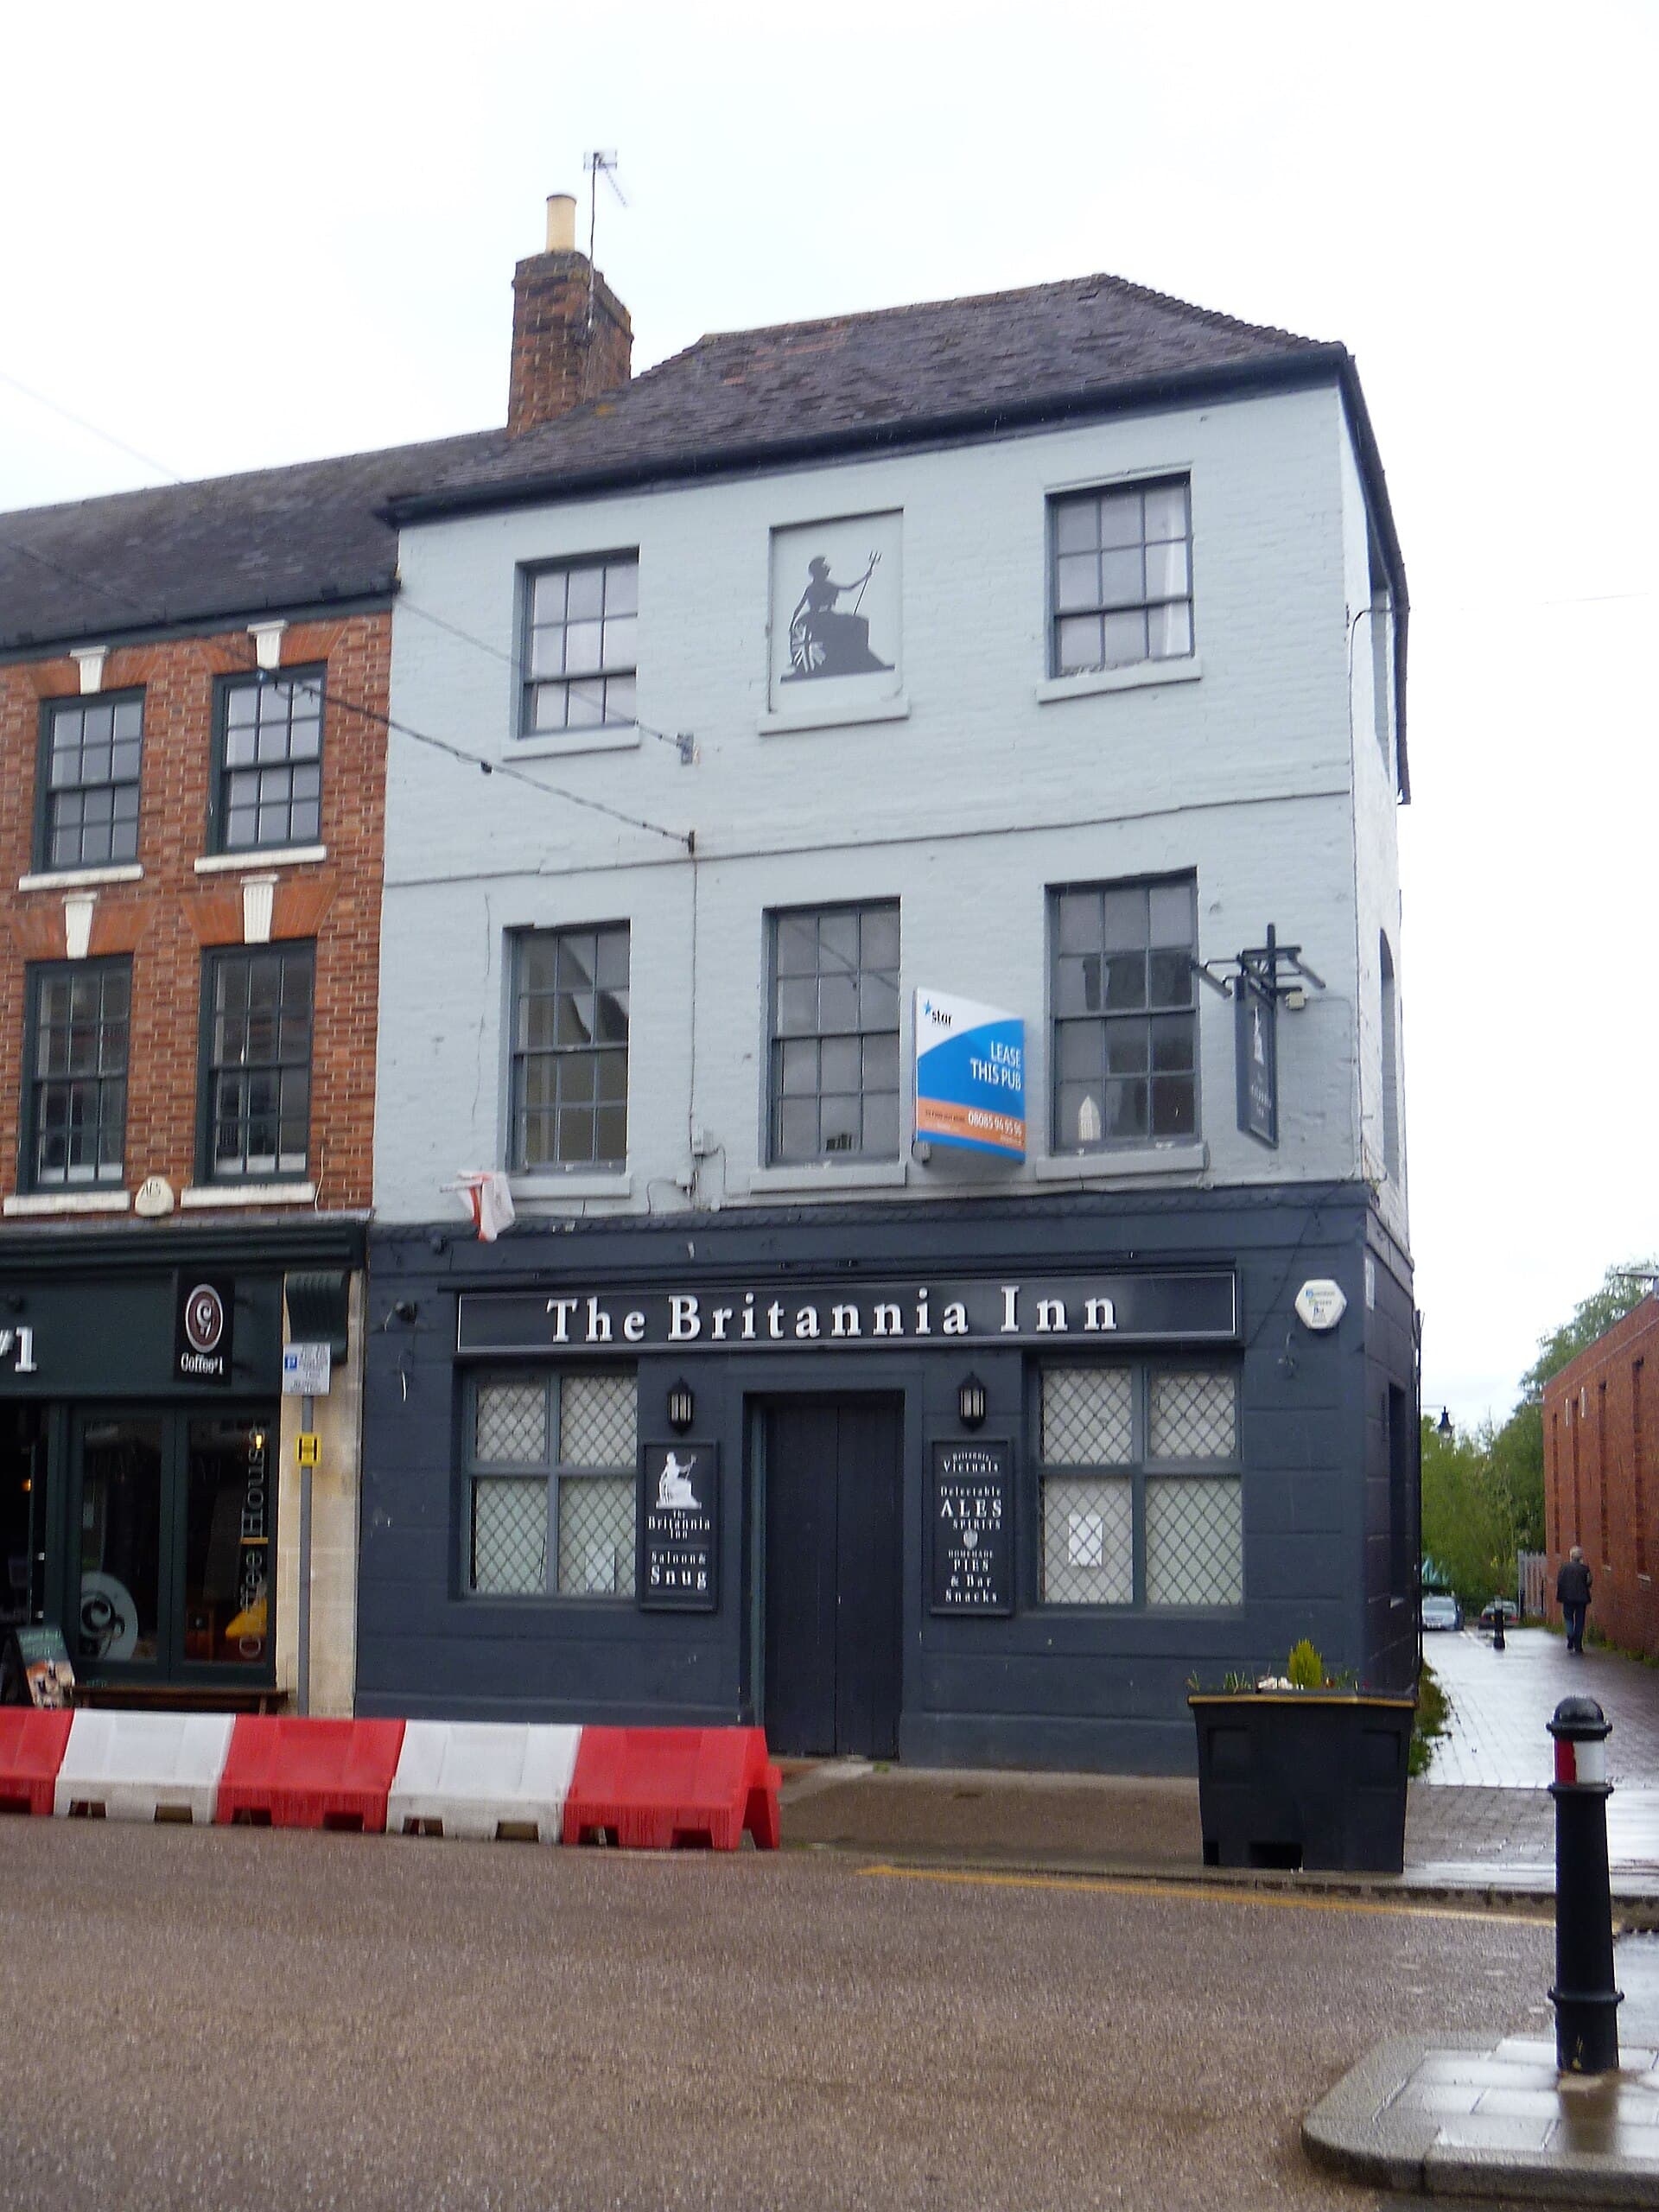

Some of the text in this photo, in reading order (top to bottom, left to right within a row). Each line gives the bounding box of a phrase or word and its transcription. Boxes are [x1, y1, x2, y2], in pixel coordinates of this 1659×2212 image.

[931, 1008, 953, 1028] star
[990, 1039, 1022, 1070] LEASE
[969, 1058, 1022, 1092] THIS PUB
[546, 1285, 1118, 1343] The Britannia Inn
[940, 1485, 1001, 1497] Delectable
[940, 1498, 1002, 1518] ALES
[648, 1515, 710, 1530] Britannia
[952, 1518, 1001, 1530] SPIRITS
[670, 1529, 689, 1540] Inn
[953, 1559, 989, 1573] PIES
[651, 1565, 707, 1591] Snug
[966, 1573, 992, 1587] Bar
[239, 1549, 264, 1658] Cffee
[944, 1589, 998, 1603] Snacks
